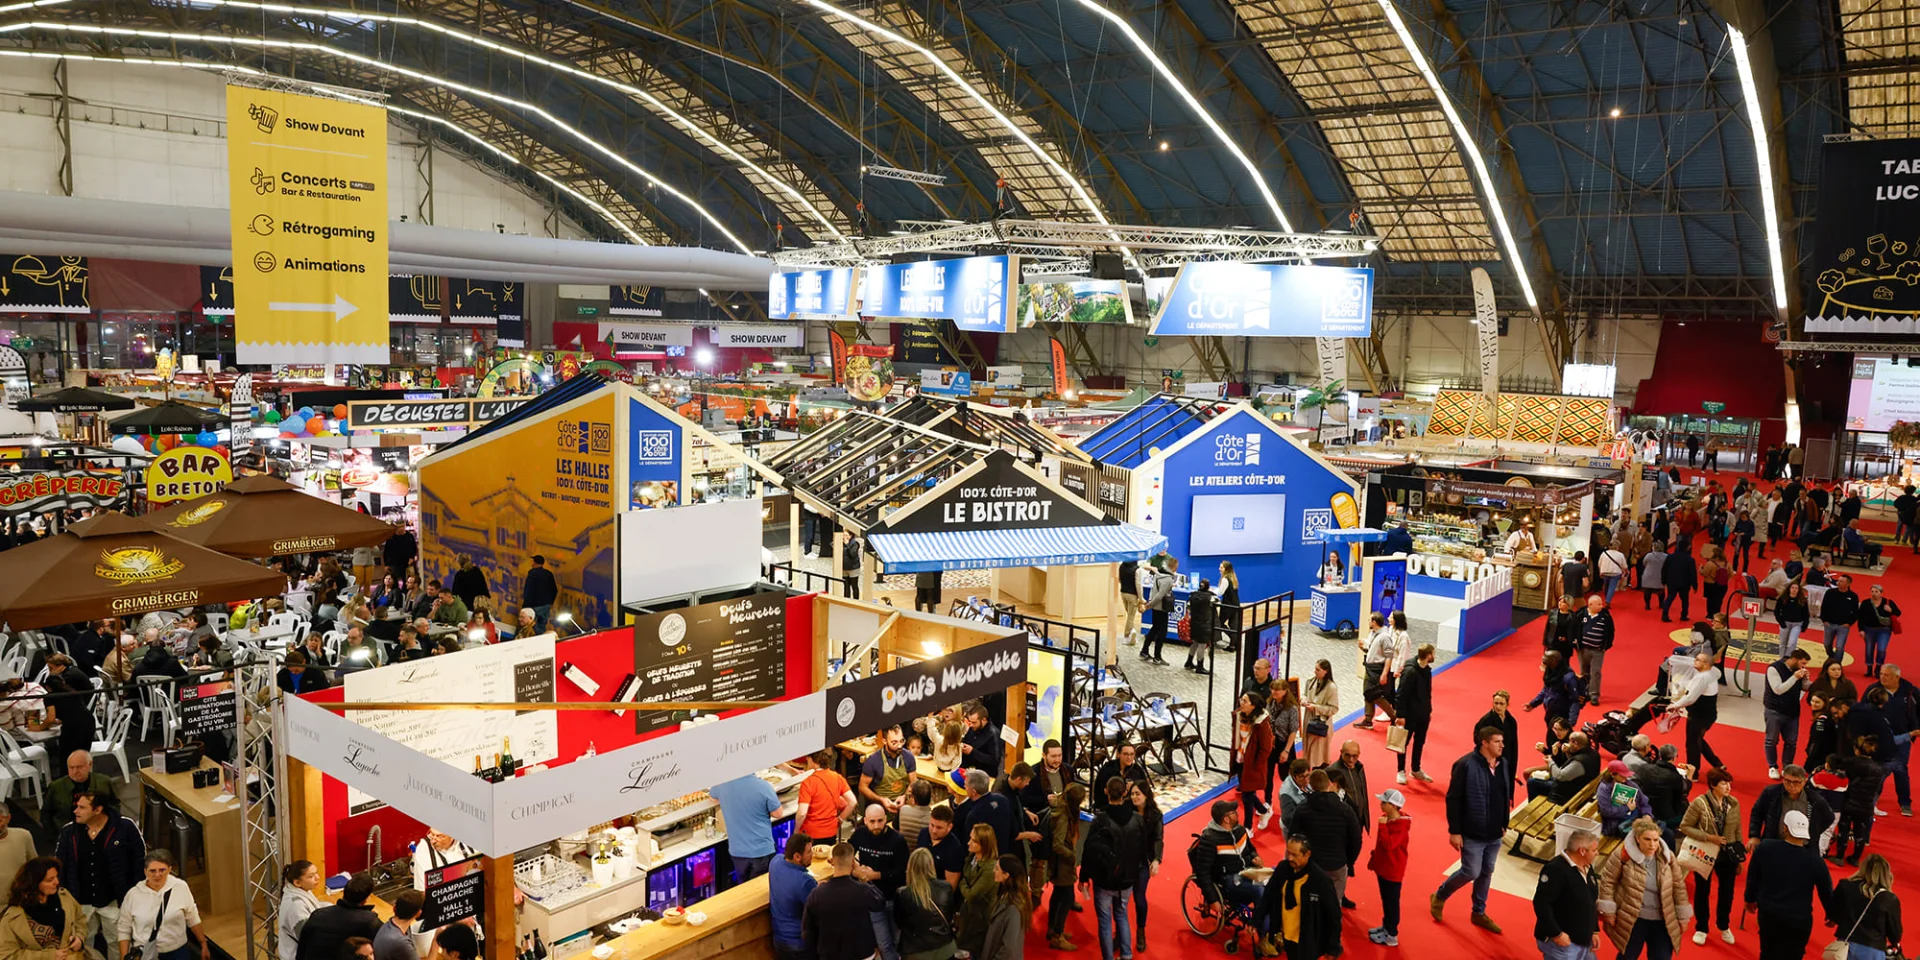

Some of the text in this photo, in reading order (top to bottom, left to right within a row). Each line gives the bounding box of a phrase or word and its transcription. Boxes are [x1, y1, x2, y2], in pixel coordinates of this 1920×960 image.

[285, 118, 365, 138] Show Devant
[281, 171, 347, 189] Concerts
[281, 187, 298, 196] Bar
[306, 190, 361, 202] Restauration
[1876, 185, 1920, 200] LUC
[283, 221, 376, 243] Rétrogaming
[284, 258, 366, 273] Animations
[621, 331, 667, 342] SHOW DEVANT
[730, 334, 787, 344] SHOW DEVANT
[364, 403, 465, 423] DÉGUSTEZ
[557, 419, 578, 433] Côte
[557, 434, 577, 449] d'Or
[594, 429, 609, 440] 100
[643, 436, 669, 447] 100
[1215, 434, 1244, 447] Côte
[1214, 446, 1243, 461] d'Or
[159, 453, 221, 478] BAR
[556, 458, 610, 480] LES HALLES
[556, 477, 610, 495] 100% CÔTE-D'OR
[1189, 473, 1286, 486] LES ATELIERS CÔTE-D'OR
[0, 474, 123, 506] CRÊPERIE
[155, 480, 226, 498] BRETON
[960, 485, 1037, 499] 100% CÔTE-D'OR
[1451, 486, 1476, 495] Fromages
[1486, 490, 1514, 498] montagnes
[943, 500, 1052, 524] LE BISTROT
[1306, 515, 1329, 526] 100
[273, 538, 335, 551] GRIMBERGEN
[943, 561, 954, 570] LE
[960, 558, 1003, 569] BISTROT
[1009, 557, 1038, 567] 100%
[112, 590, 199, 611] GRIMBERGEN
[729, 606, 781, 624] Meurette
[675, 645, 687, 656] 10
[941, 650, 1021, 693] Meurette
[652, 675, 661, 685] DE
[183, 699, 235, 713] INTERNATIONALE
[187, 710, 233, 724] GASTRONOMIE
[184, 728, 201, 736] HALL
[342, 743, 381, 777] Lagache
[631, 750, 674, 767] CHAMPAGNE
[619, 763, 681, 794] Lagache
[431, 876, 479, 898] CHAMPAGNE
[437, 886, 474, 904] LAGACHE
[443, 901, 463, 913] HALL
[464, 905, 473, 914] 35
